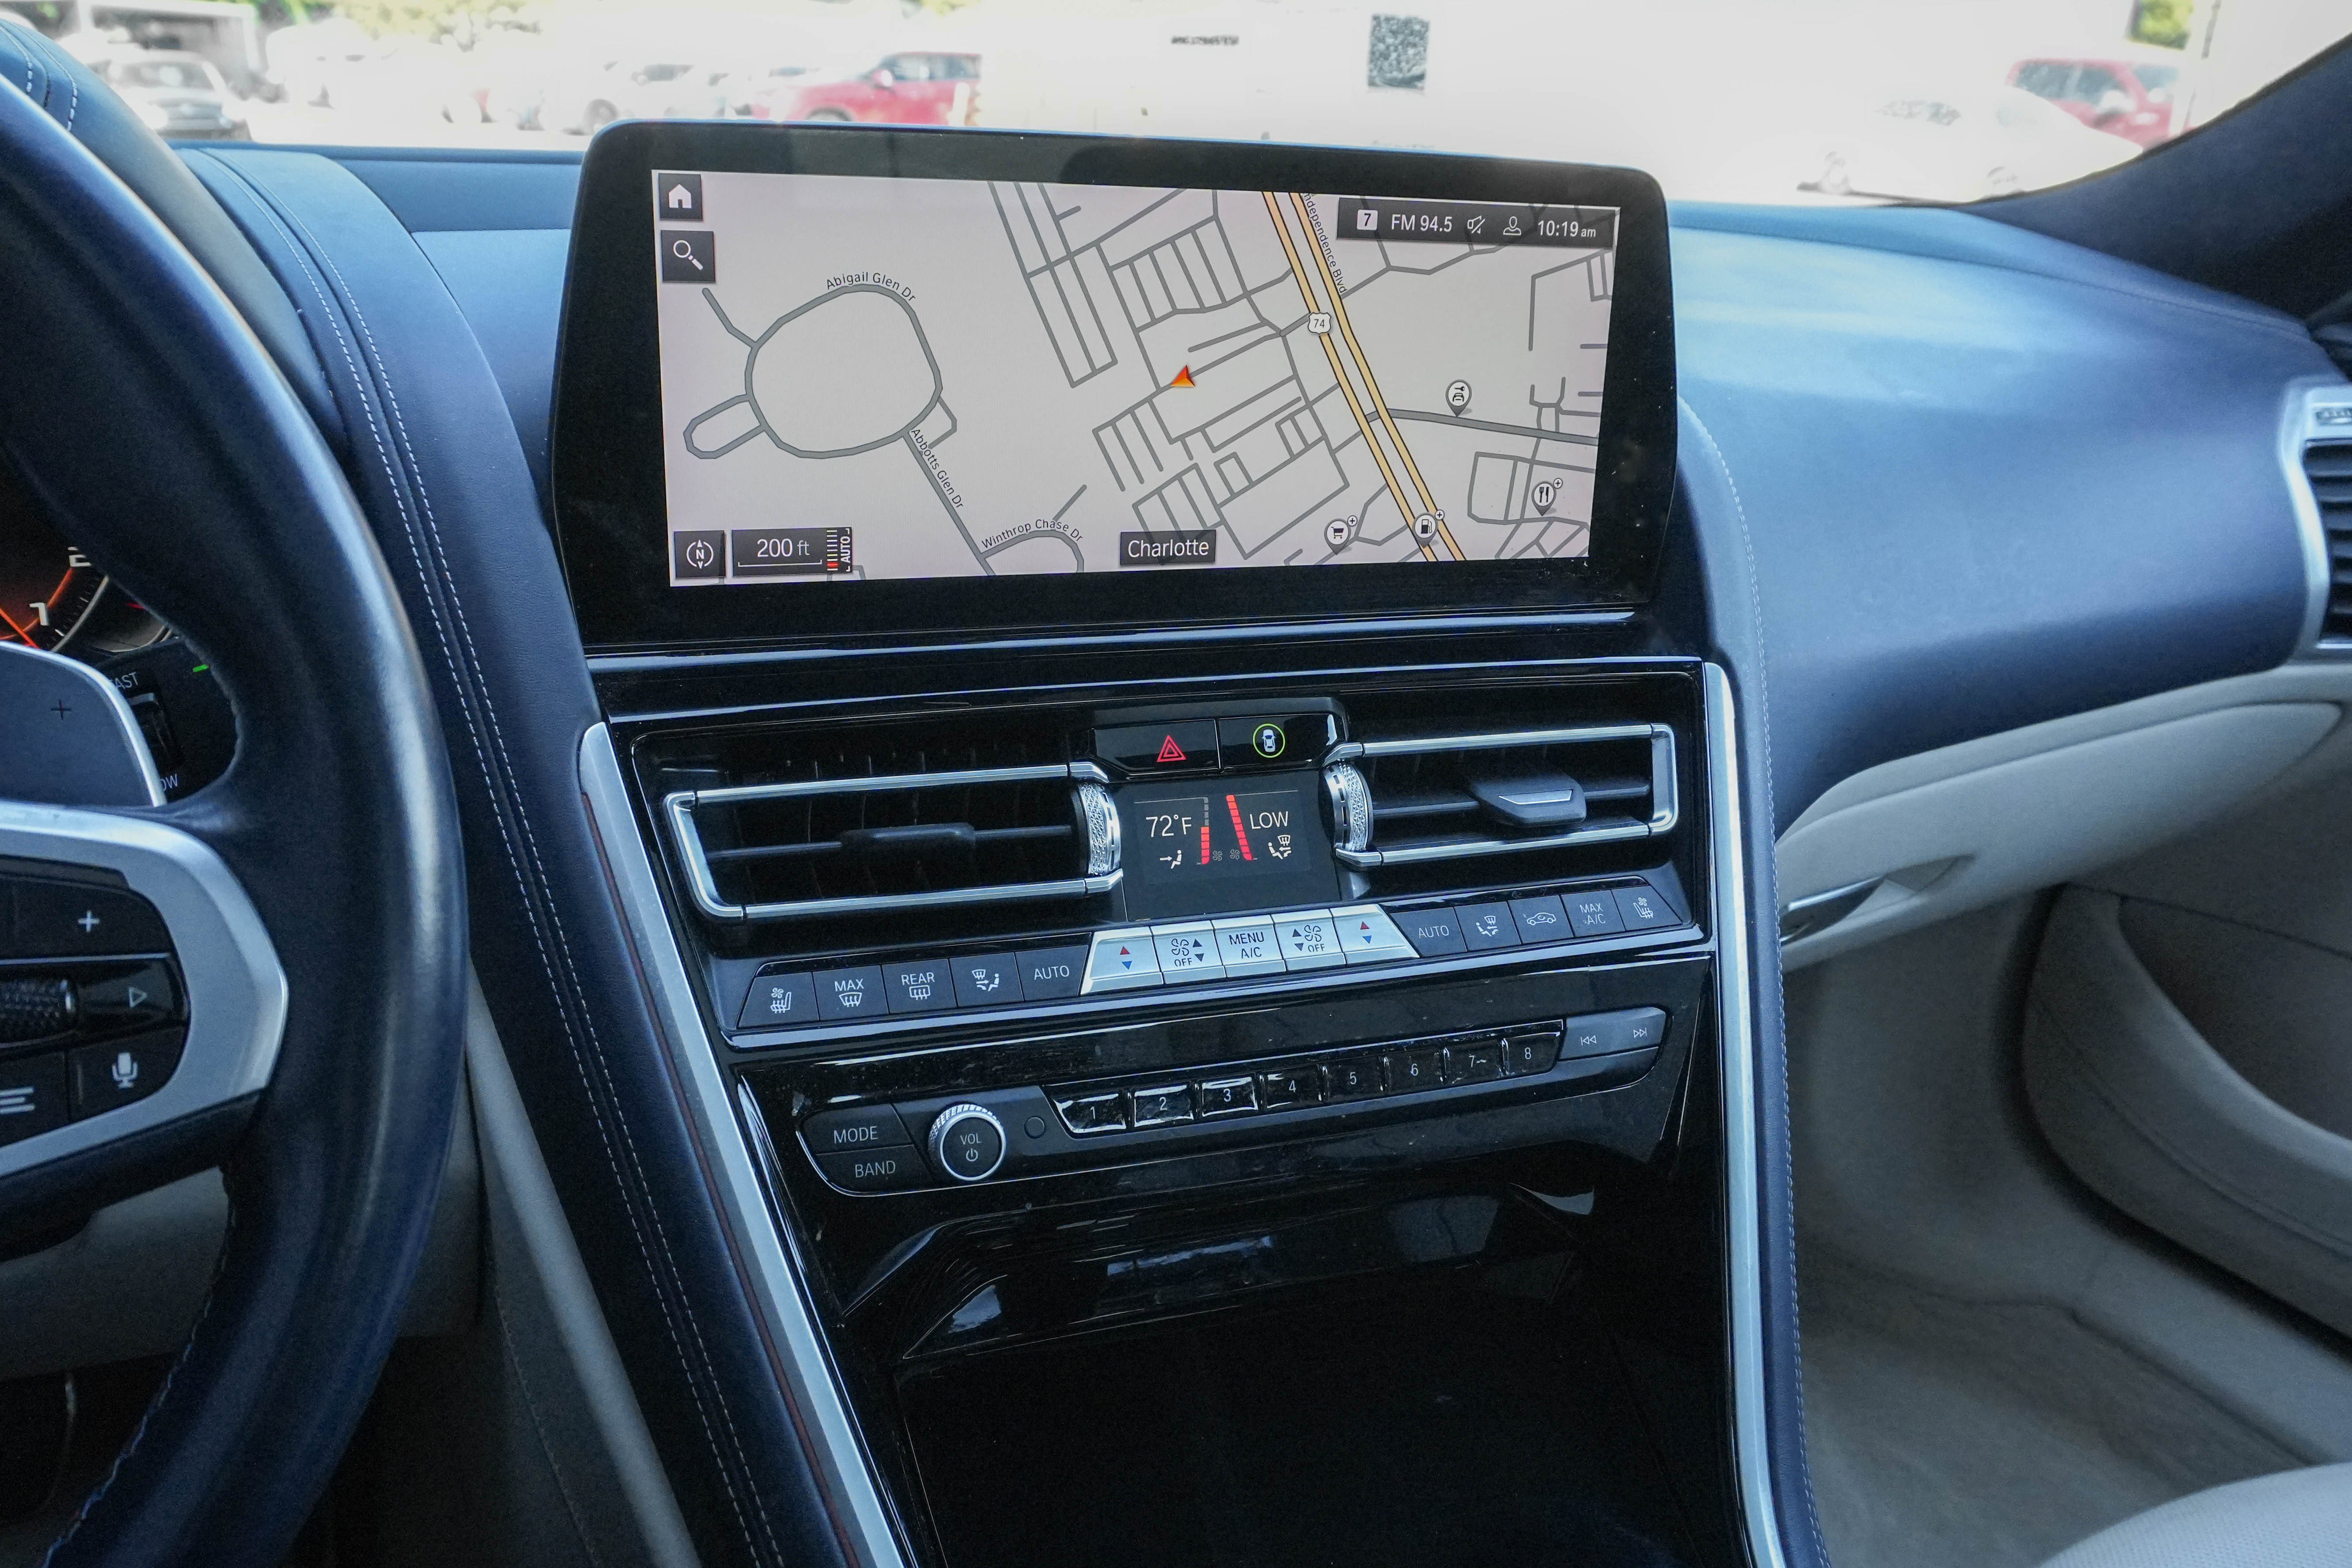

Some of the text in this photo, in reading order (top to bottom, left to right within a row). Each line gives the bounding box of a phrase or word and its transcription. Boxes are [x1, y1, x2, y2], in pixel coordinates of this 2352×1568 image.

[1363, 213, 1453, 232] 7 FM 94.5
[1538, 220, 1596, 238] 10:19 am
[1303, 193, 1348, 293] ndependence Blvd
[826, 271, 916, 302] Abigail Glen Dr
[1314, 318, 1325, 328] 74
[910, 429, 964, 508] Abbotts Glen Dr
[981, 519, 1083, 549] Winthrop Chase Dr
[757, 538, 810, 558] 200 ft
[840, 536, 851, 564] AUTO
[1128, 538, 1209, 558] Charlotte
[112, 671, 139, 689] AST
[1145, 814, 1192, 838] 72°F
[1249, 811, 1289, 830] LOW
[1579, 902, 1604, 914] MAX
[1587, 913, 1606, 925] A/C
[1228, 931, 1265, 945] MENU
[1418, 924, 1450, 939] AUTO
[1241, 946, 1262, 959] A/C
[1308, 943, 1326, 953] OFF
[1174, 957, 1193, 967] OFF
[901, 971, 935, 986] REAR
[1034, 965, 1070, 981] AUTO
[834, 978, 864, 992] MAX
[1524, 1047, 1532, 1060] 8
[1468, 1055, 1475, 1068] 7
[1410, 1063, 1419, 1076] 6
[1288, 1079, 1297, 1093] 4
[1349, 1072, 1357, 1085] 5
[1223, 1088, 1232, 1102] 3
[1159, 1096, 1168, 1111] 2
[1089, 1106, 1096, 1120] 1
[833, 1125, 879, 1144] MODE
[959, 1133, 982, 1145] VOL
[854, 1160, 896, 1178] BAND
